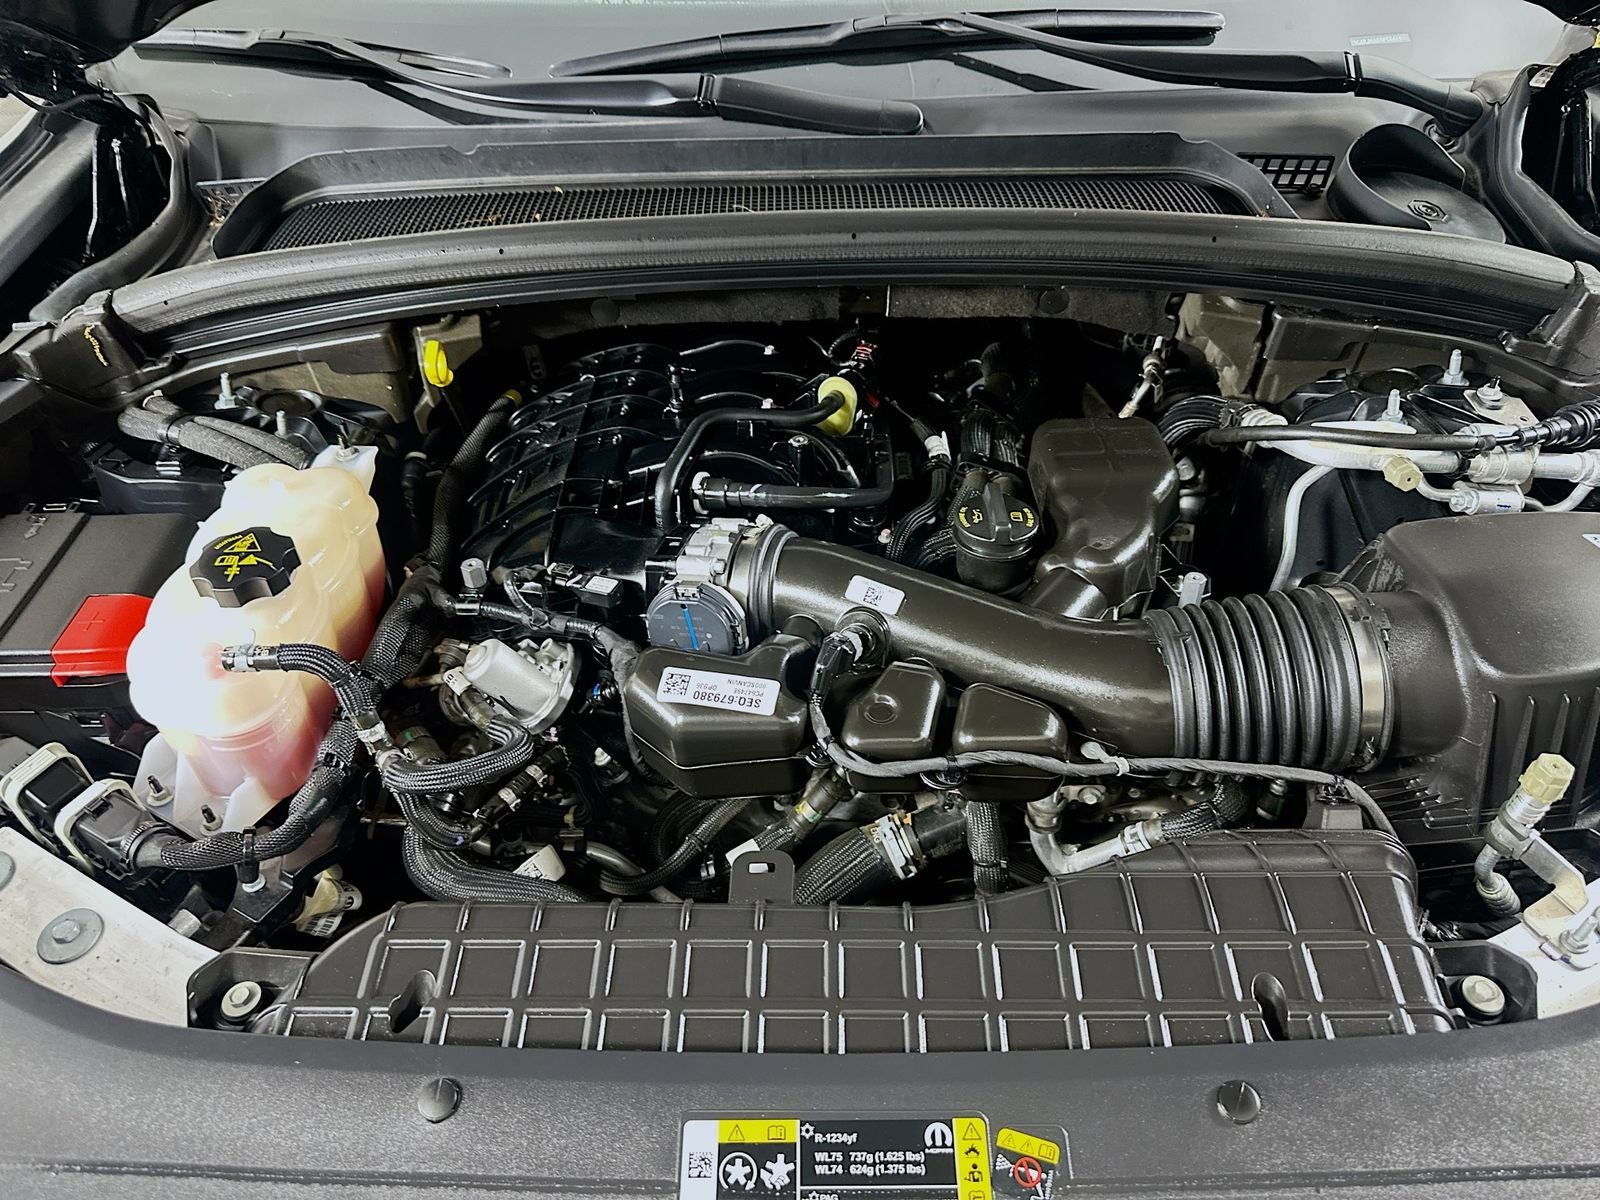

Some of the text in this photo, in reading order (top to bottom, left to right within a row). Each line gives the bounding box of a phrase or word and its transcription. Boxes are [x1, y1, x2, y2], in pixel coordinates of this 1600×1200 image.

[692, 690, 762, 708] SEQ:679380
[814, 1133, 858, 1145] R-1234yf
[814, 1151, 926, 1163] WL75 737g (1.625 lbs)
[814, 1164, 926, 1177] WL74 624g (1.375 lbs)
